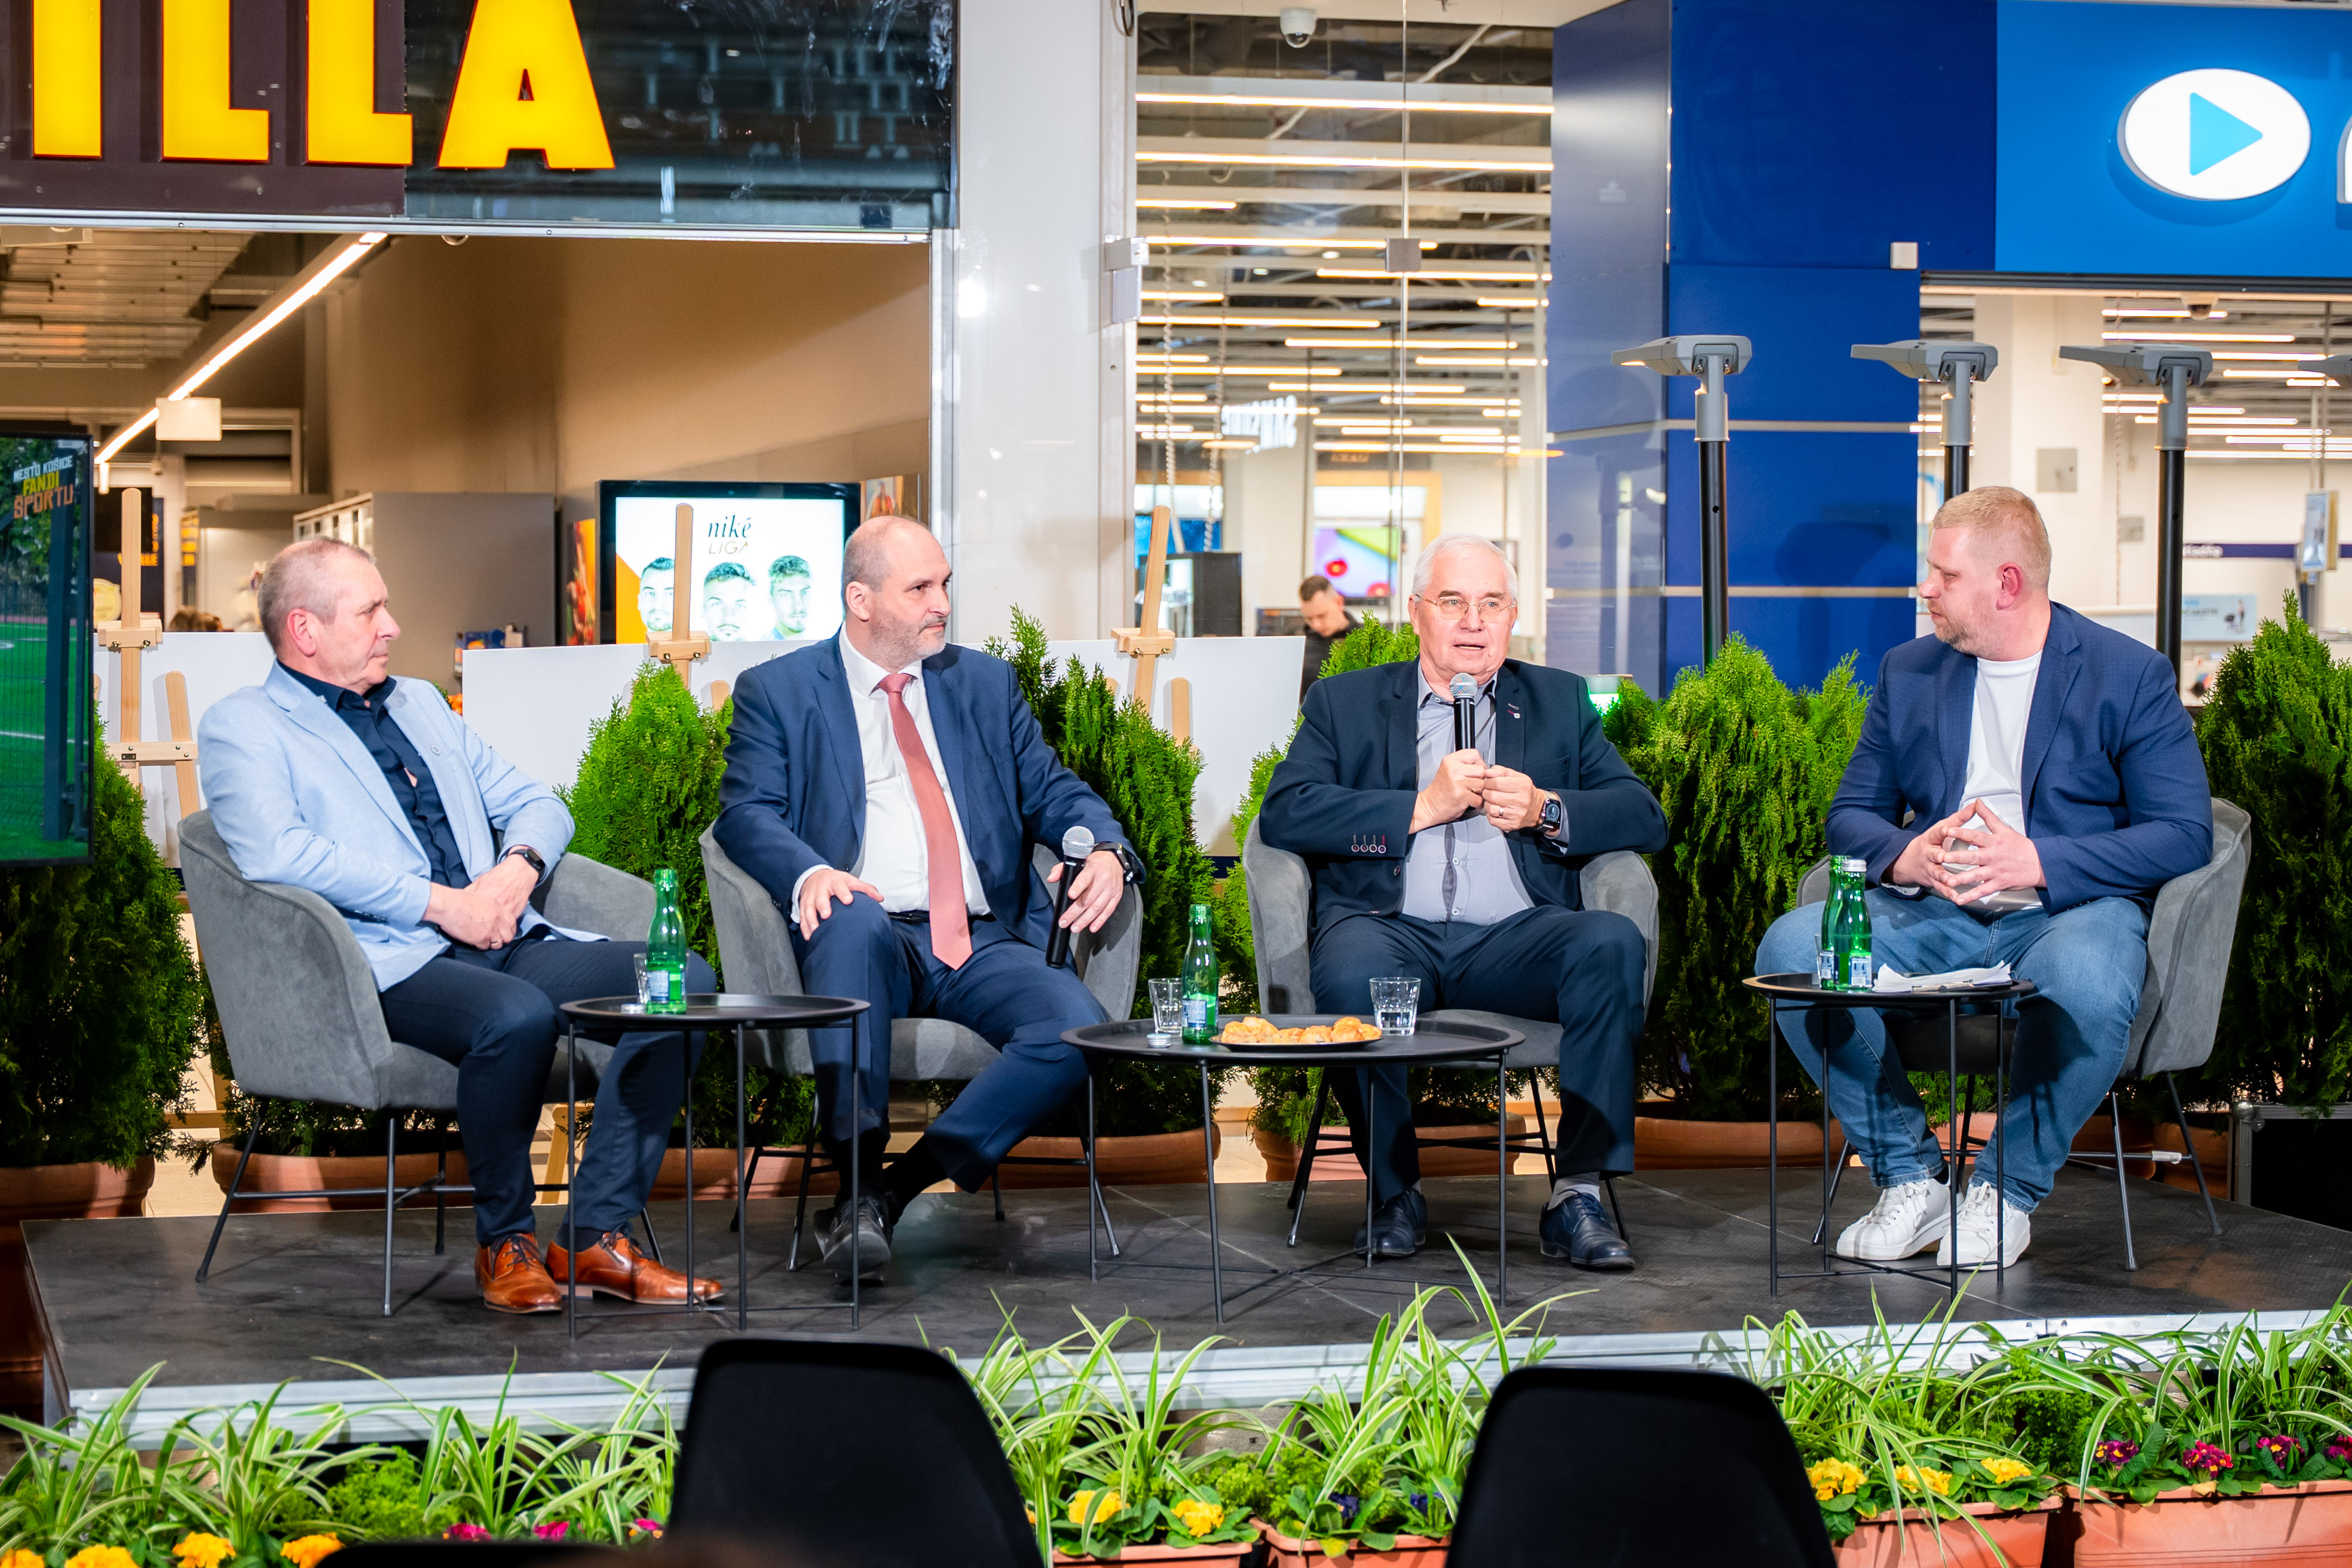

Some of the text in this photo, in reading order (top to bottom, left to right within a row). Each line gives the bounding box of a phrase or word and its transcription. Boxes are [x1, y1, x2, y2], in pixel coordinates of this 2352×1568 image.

[13, 455, 73, 482] MESTO KOŠICE
[23, 471, 60, 496] FANDI
[14, 484, 74, 519] ŠPORTU
[708, 514, 751, 538] niké
